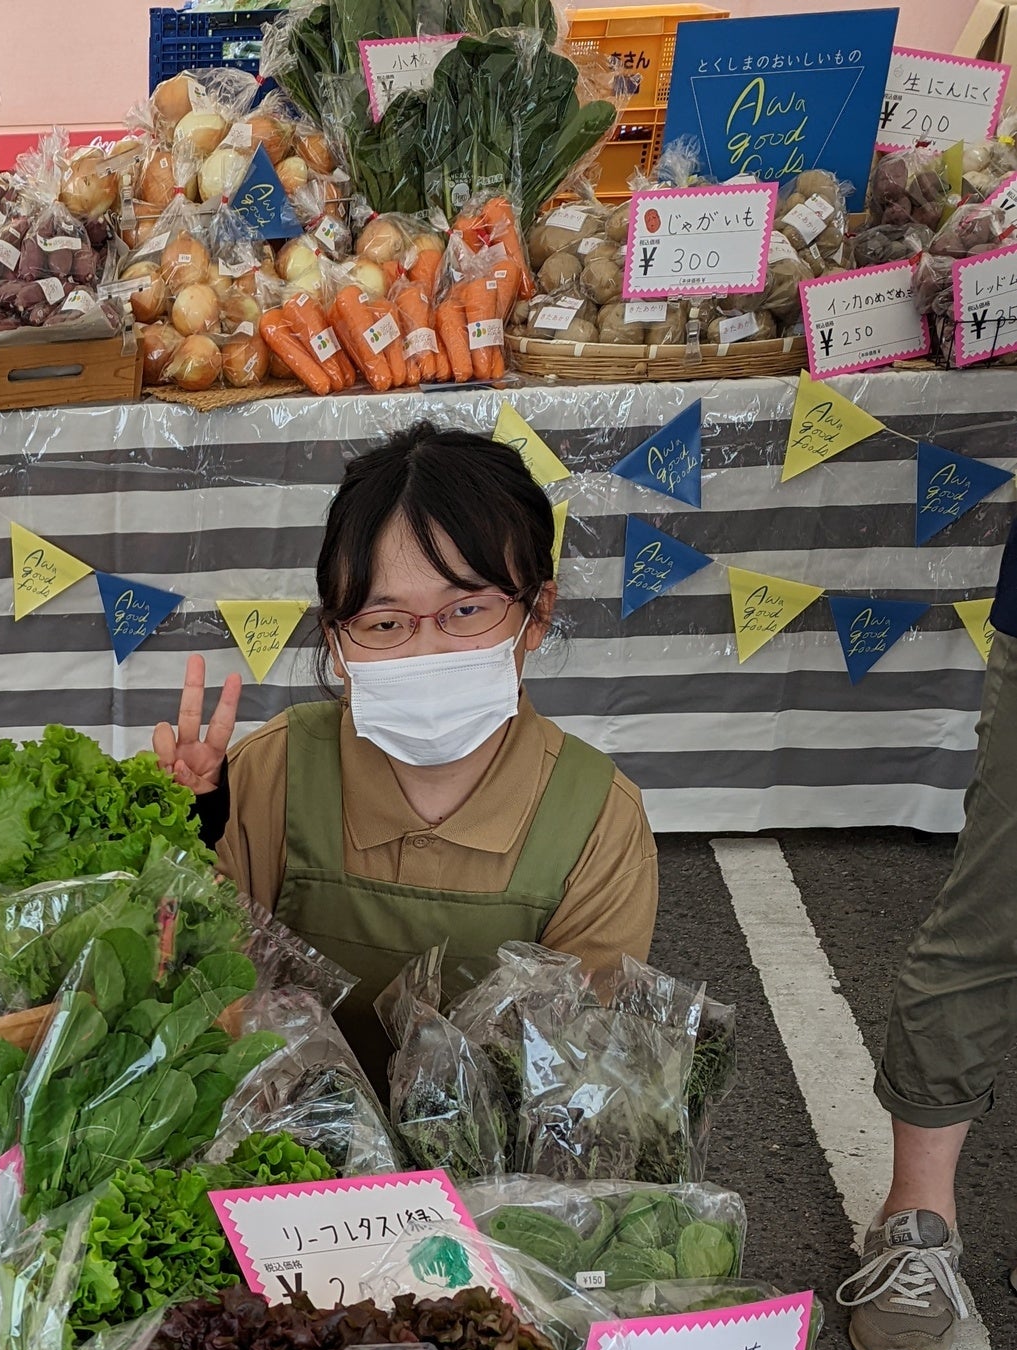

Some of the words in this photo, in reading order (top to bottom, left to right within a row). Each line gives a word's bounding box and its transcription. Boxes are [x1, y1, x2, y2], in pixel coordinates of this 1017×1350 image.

[698, 50, 862, 73] とくしまのおいしいもの
[903, 72, 991, 102] 生にんにく
[726, 77, 806, 134] Awa
[727, 116, 809, 164] good
[740, 146, 805, 180] foods
[668, 207, 755, 235] じゃがいも
[264, 1260, 303, 1274] 税込価格
[583, 1275, 603, 1285] ¥150
